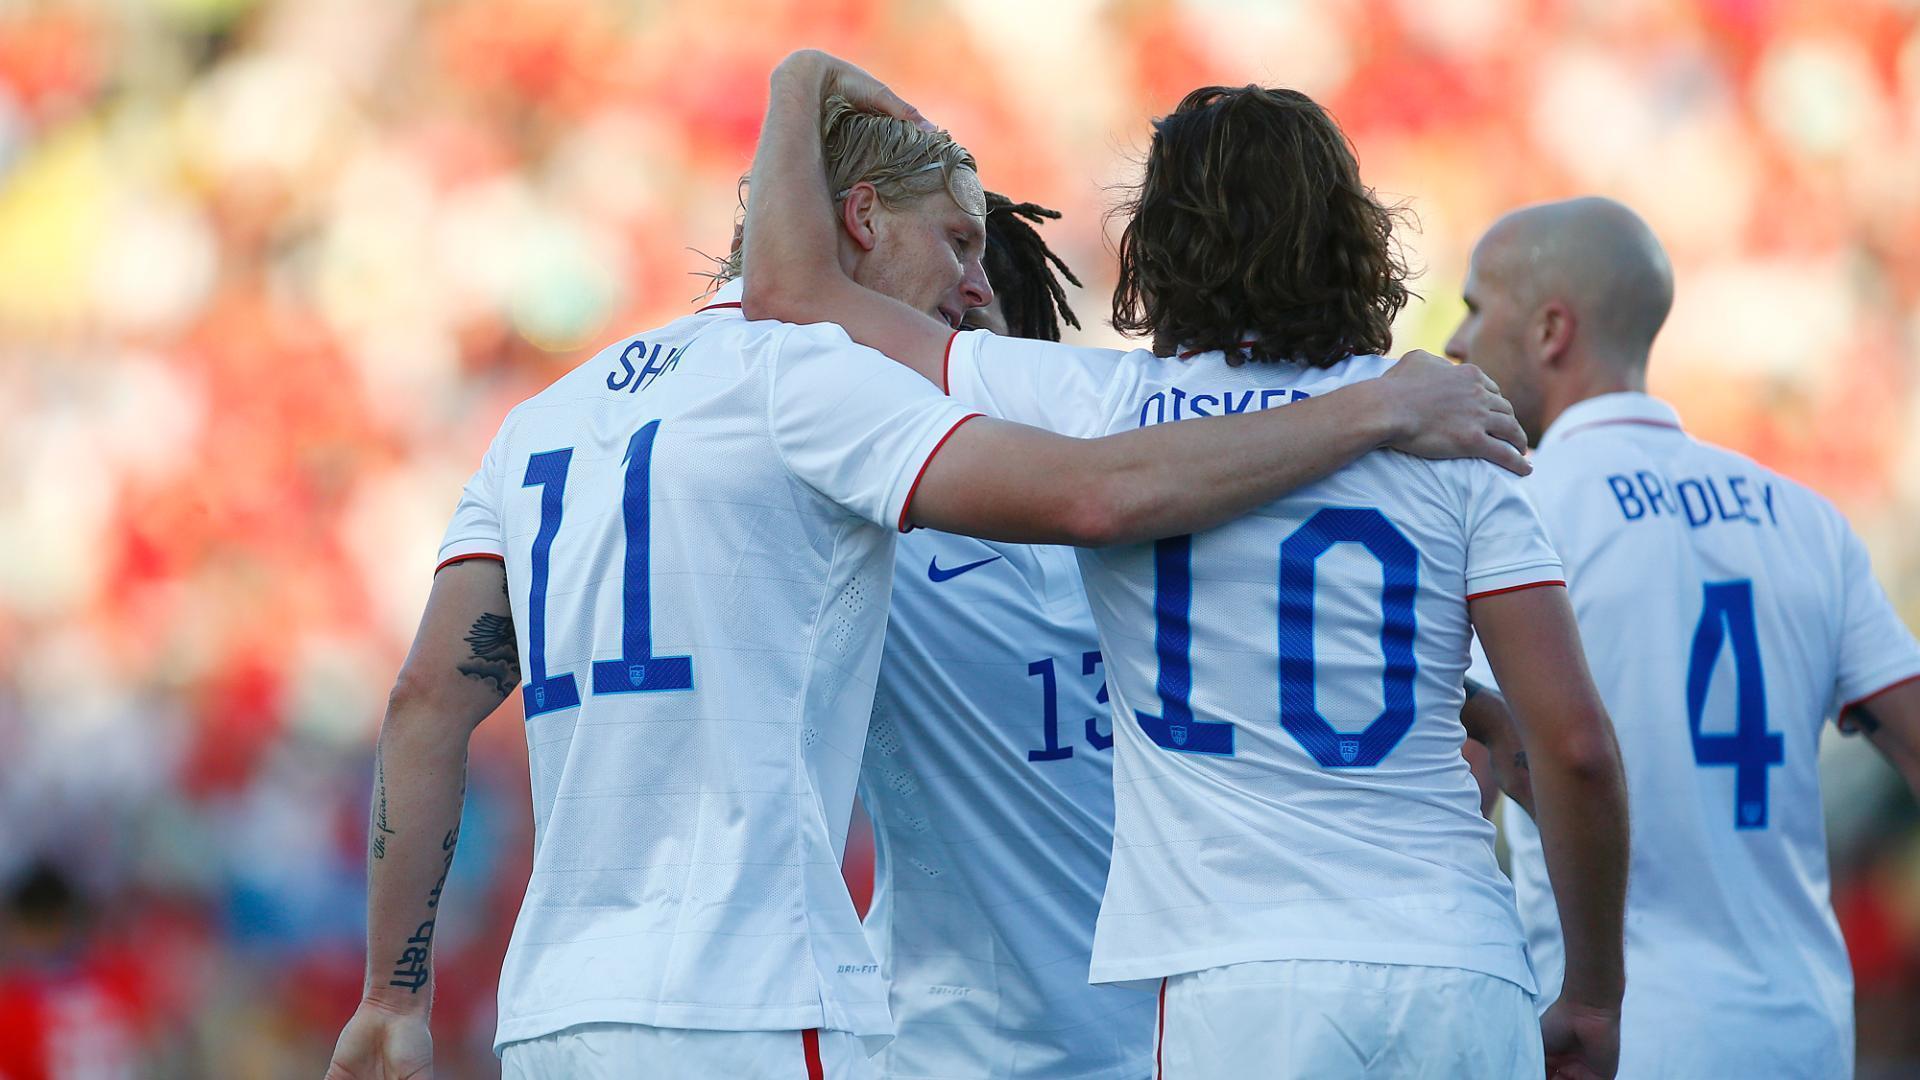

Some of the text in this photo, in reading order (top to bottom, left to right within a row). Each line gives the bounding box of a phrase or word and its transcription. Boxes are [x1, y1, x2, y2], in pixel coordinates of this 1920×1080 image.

[1607, 471, 1777, 528] BRDLEY
[522, 418, 694, 721] 11
[1134, 507, 1419, 768] 10
[1028, 651, 1114, 762] 13
[1686, 578, 1785, 831] 4
[373, 834, 386, 859] The
[376, 799, 395, 834] future
[837, 965, 879, 974] DRI-FIT
